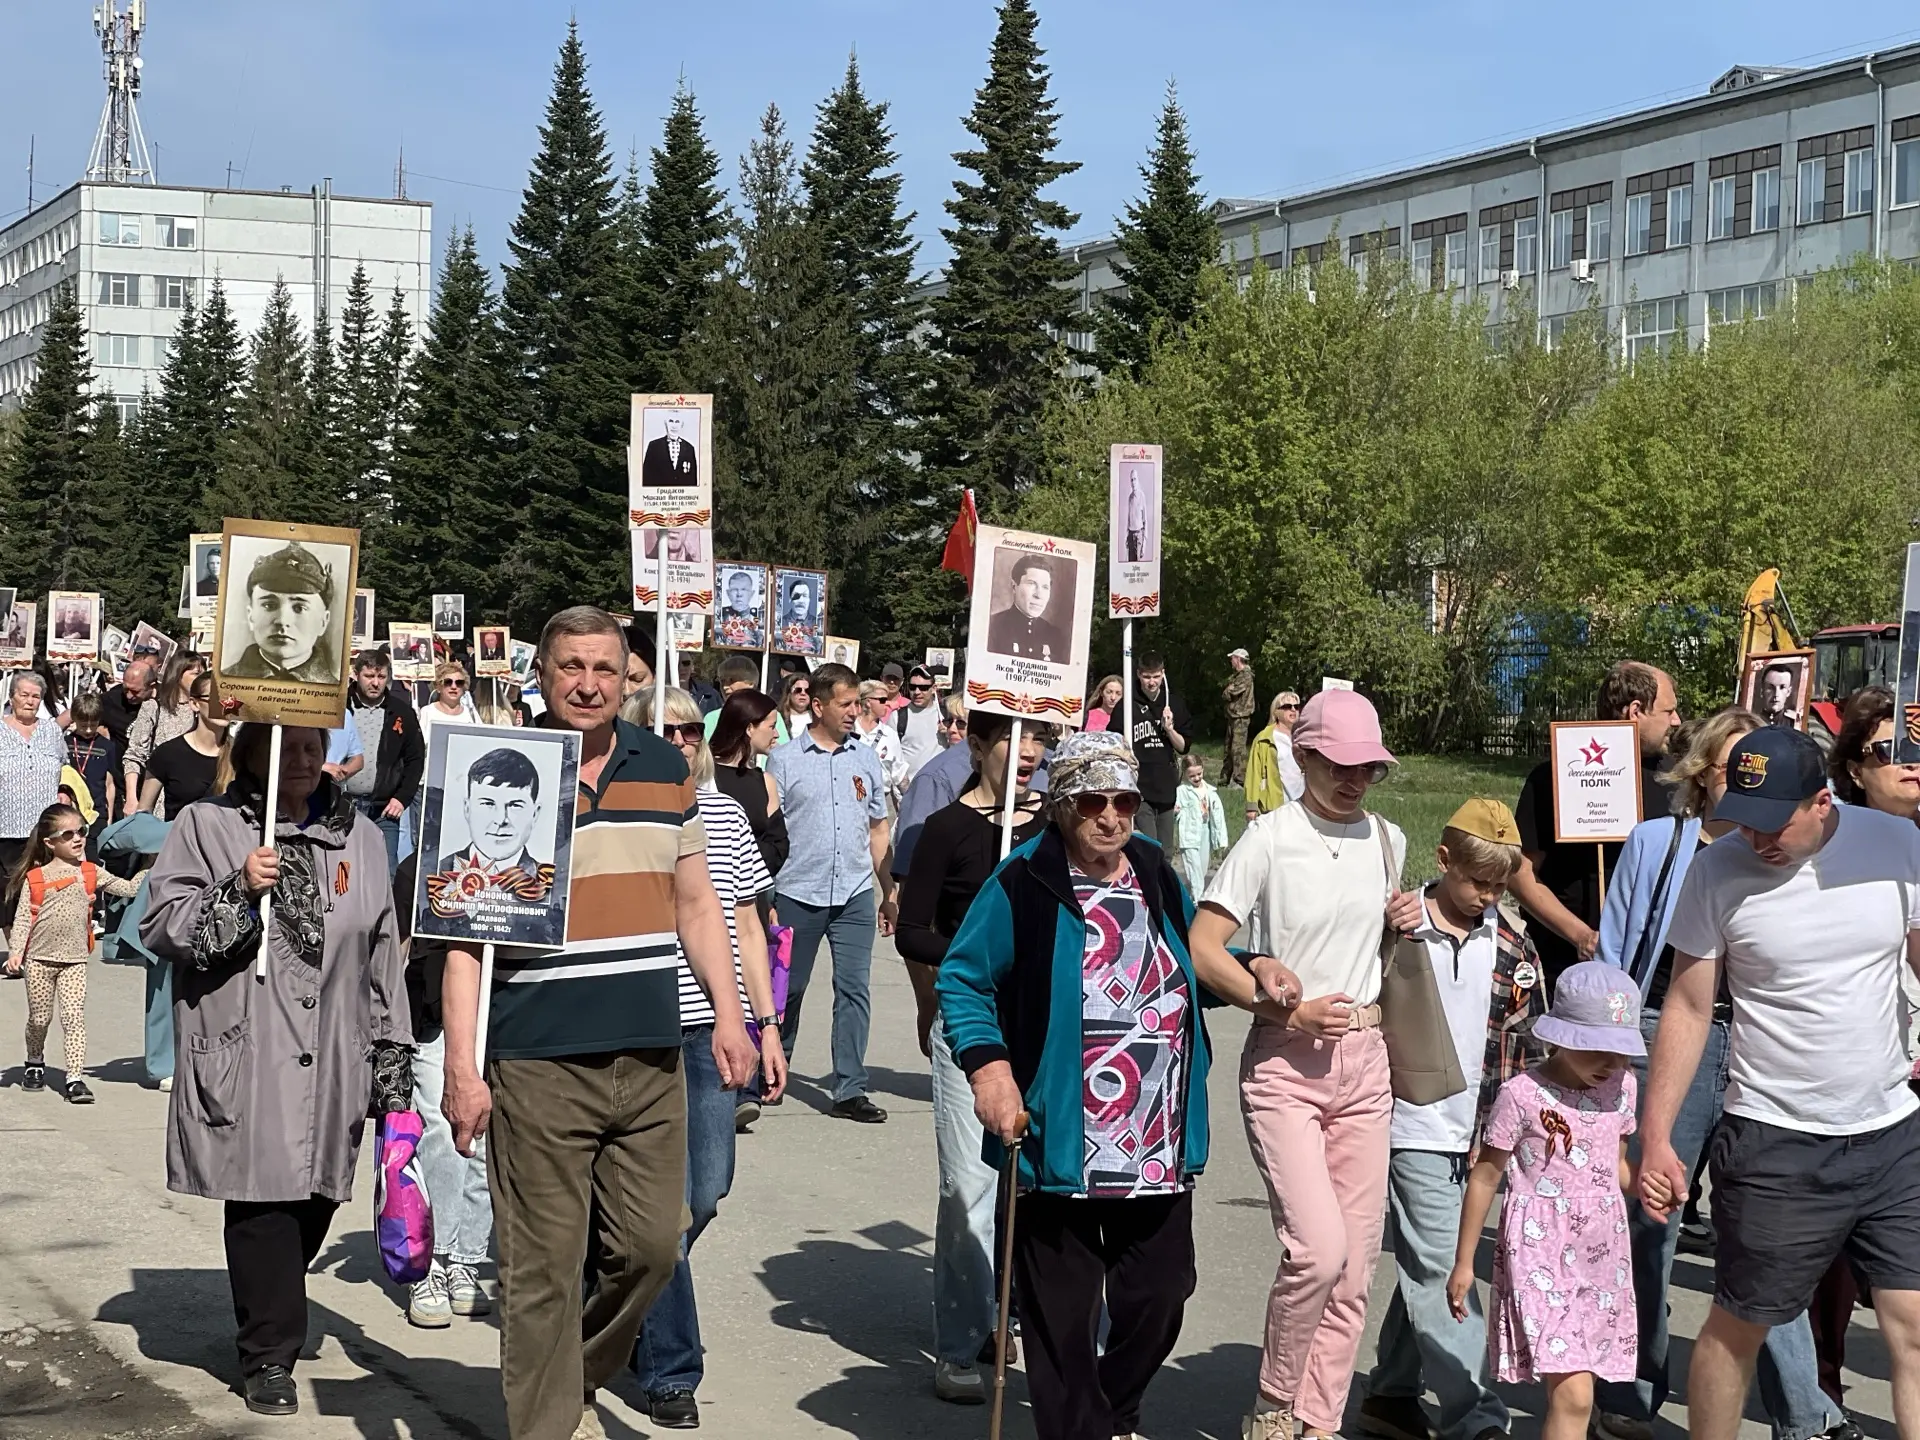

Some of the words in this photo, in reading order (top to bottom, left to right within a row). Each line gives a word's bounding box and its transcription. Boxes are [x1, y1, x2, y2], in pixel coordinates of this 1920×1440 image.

[996, 664, 1014, 673] Яков
[1017, 667, 1062, 681] Корнилович
[1005, 672, 1051, 686] (1907-1969)
[219, 682, 255, 692] Сорокин
[257, 684, 297, 695] Геннадий
[299, 688, 340, 698] Петрович
[1586, 801, 1609, 809] Юшин
[474, 889, 513, 901] Кононов
[438, 899, 476, 911] Филипп
[477, 901, 548, 917] Митрофанович
[476, 914, 507, 924] рядовой
